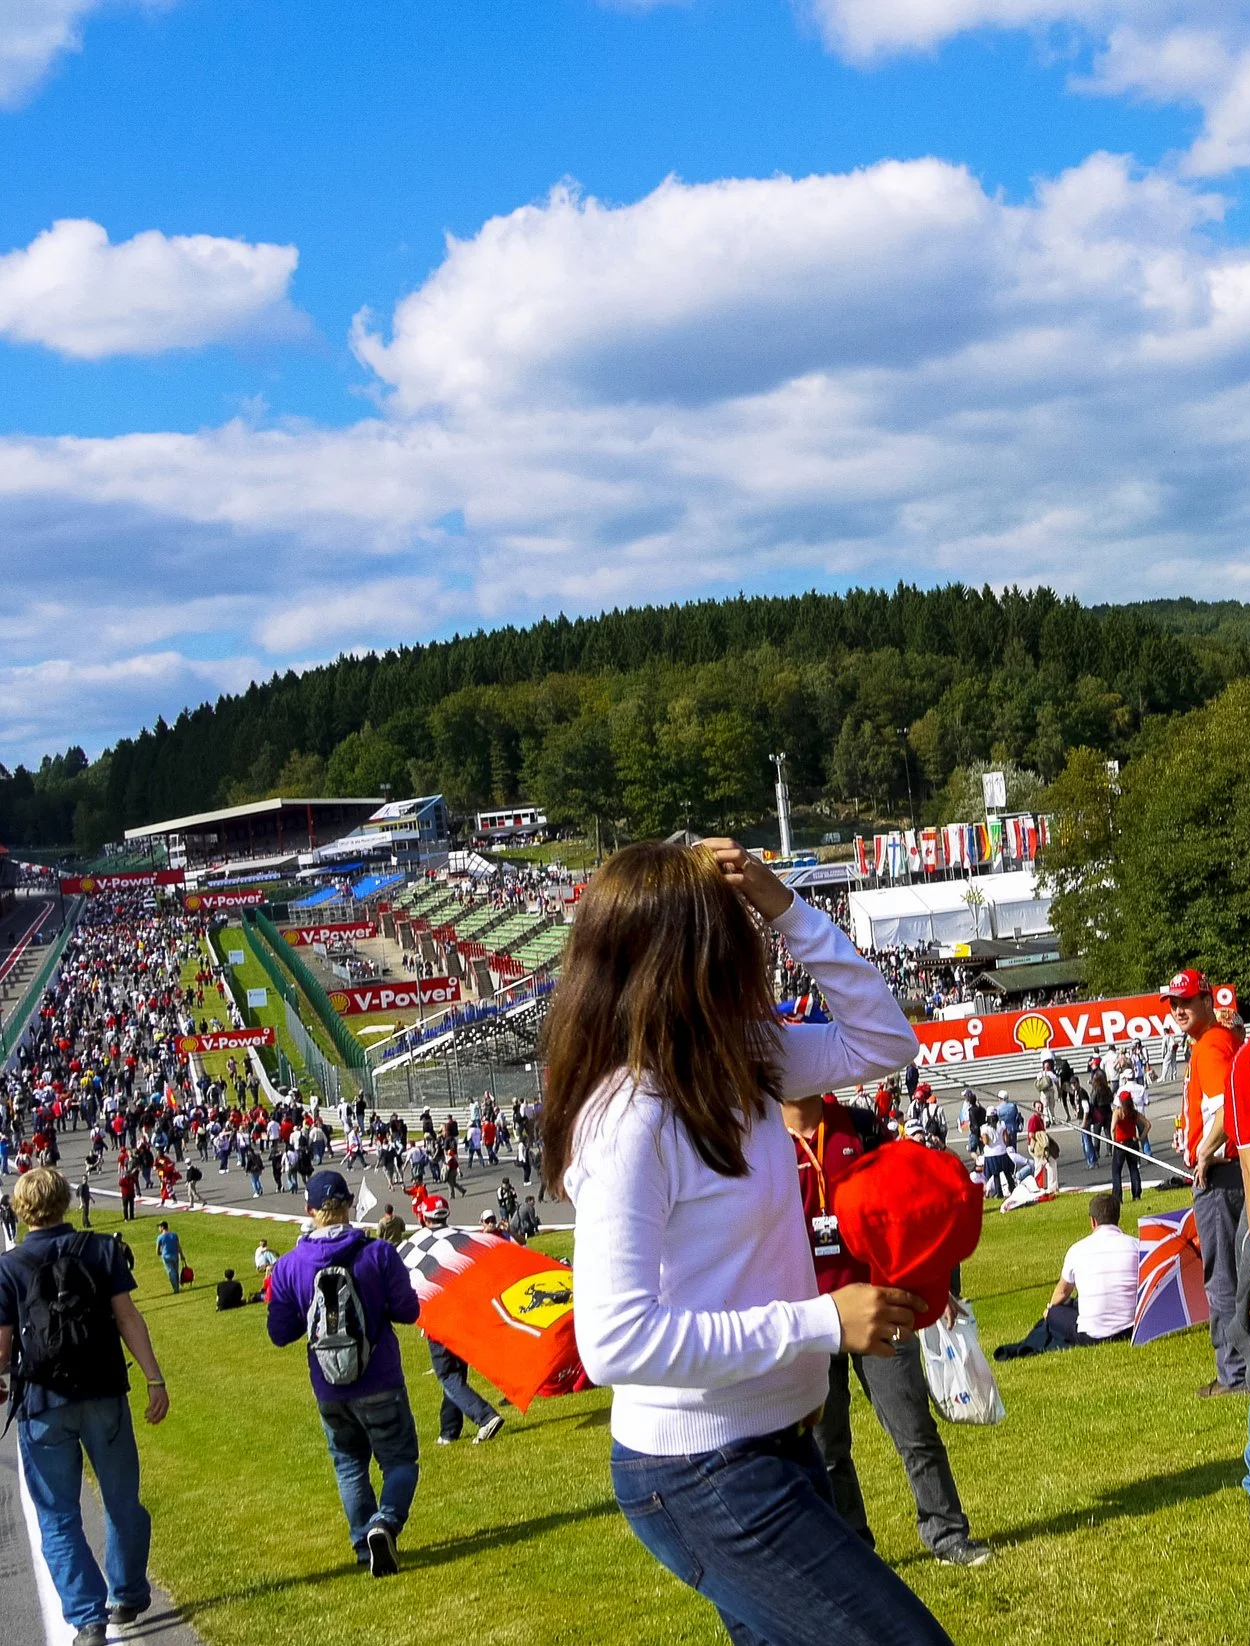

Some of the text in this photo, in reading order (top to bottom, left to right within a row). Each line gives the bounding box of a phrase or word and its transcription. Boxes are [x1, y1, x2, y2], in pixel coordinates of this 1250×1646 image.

[97, 875, 156, 889] V-Power
[202, 893, 262, 908] V-Power
[302, 927, 372, 943] V-Power
[354, 986, 456, 1011] V-Power
[1059, 1011, 1183, 1046] V-Pow
[202, 1035, 268, 1050] V-Power
[914, 1036, 979, 1066] wer
